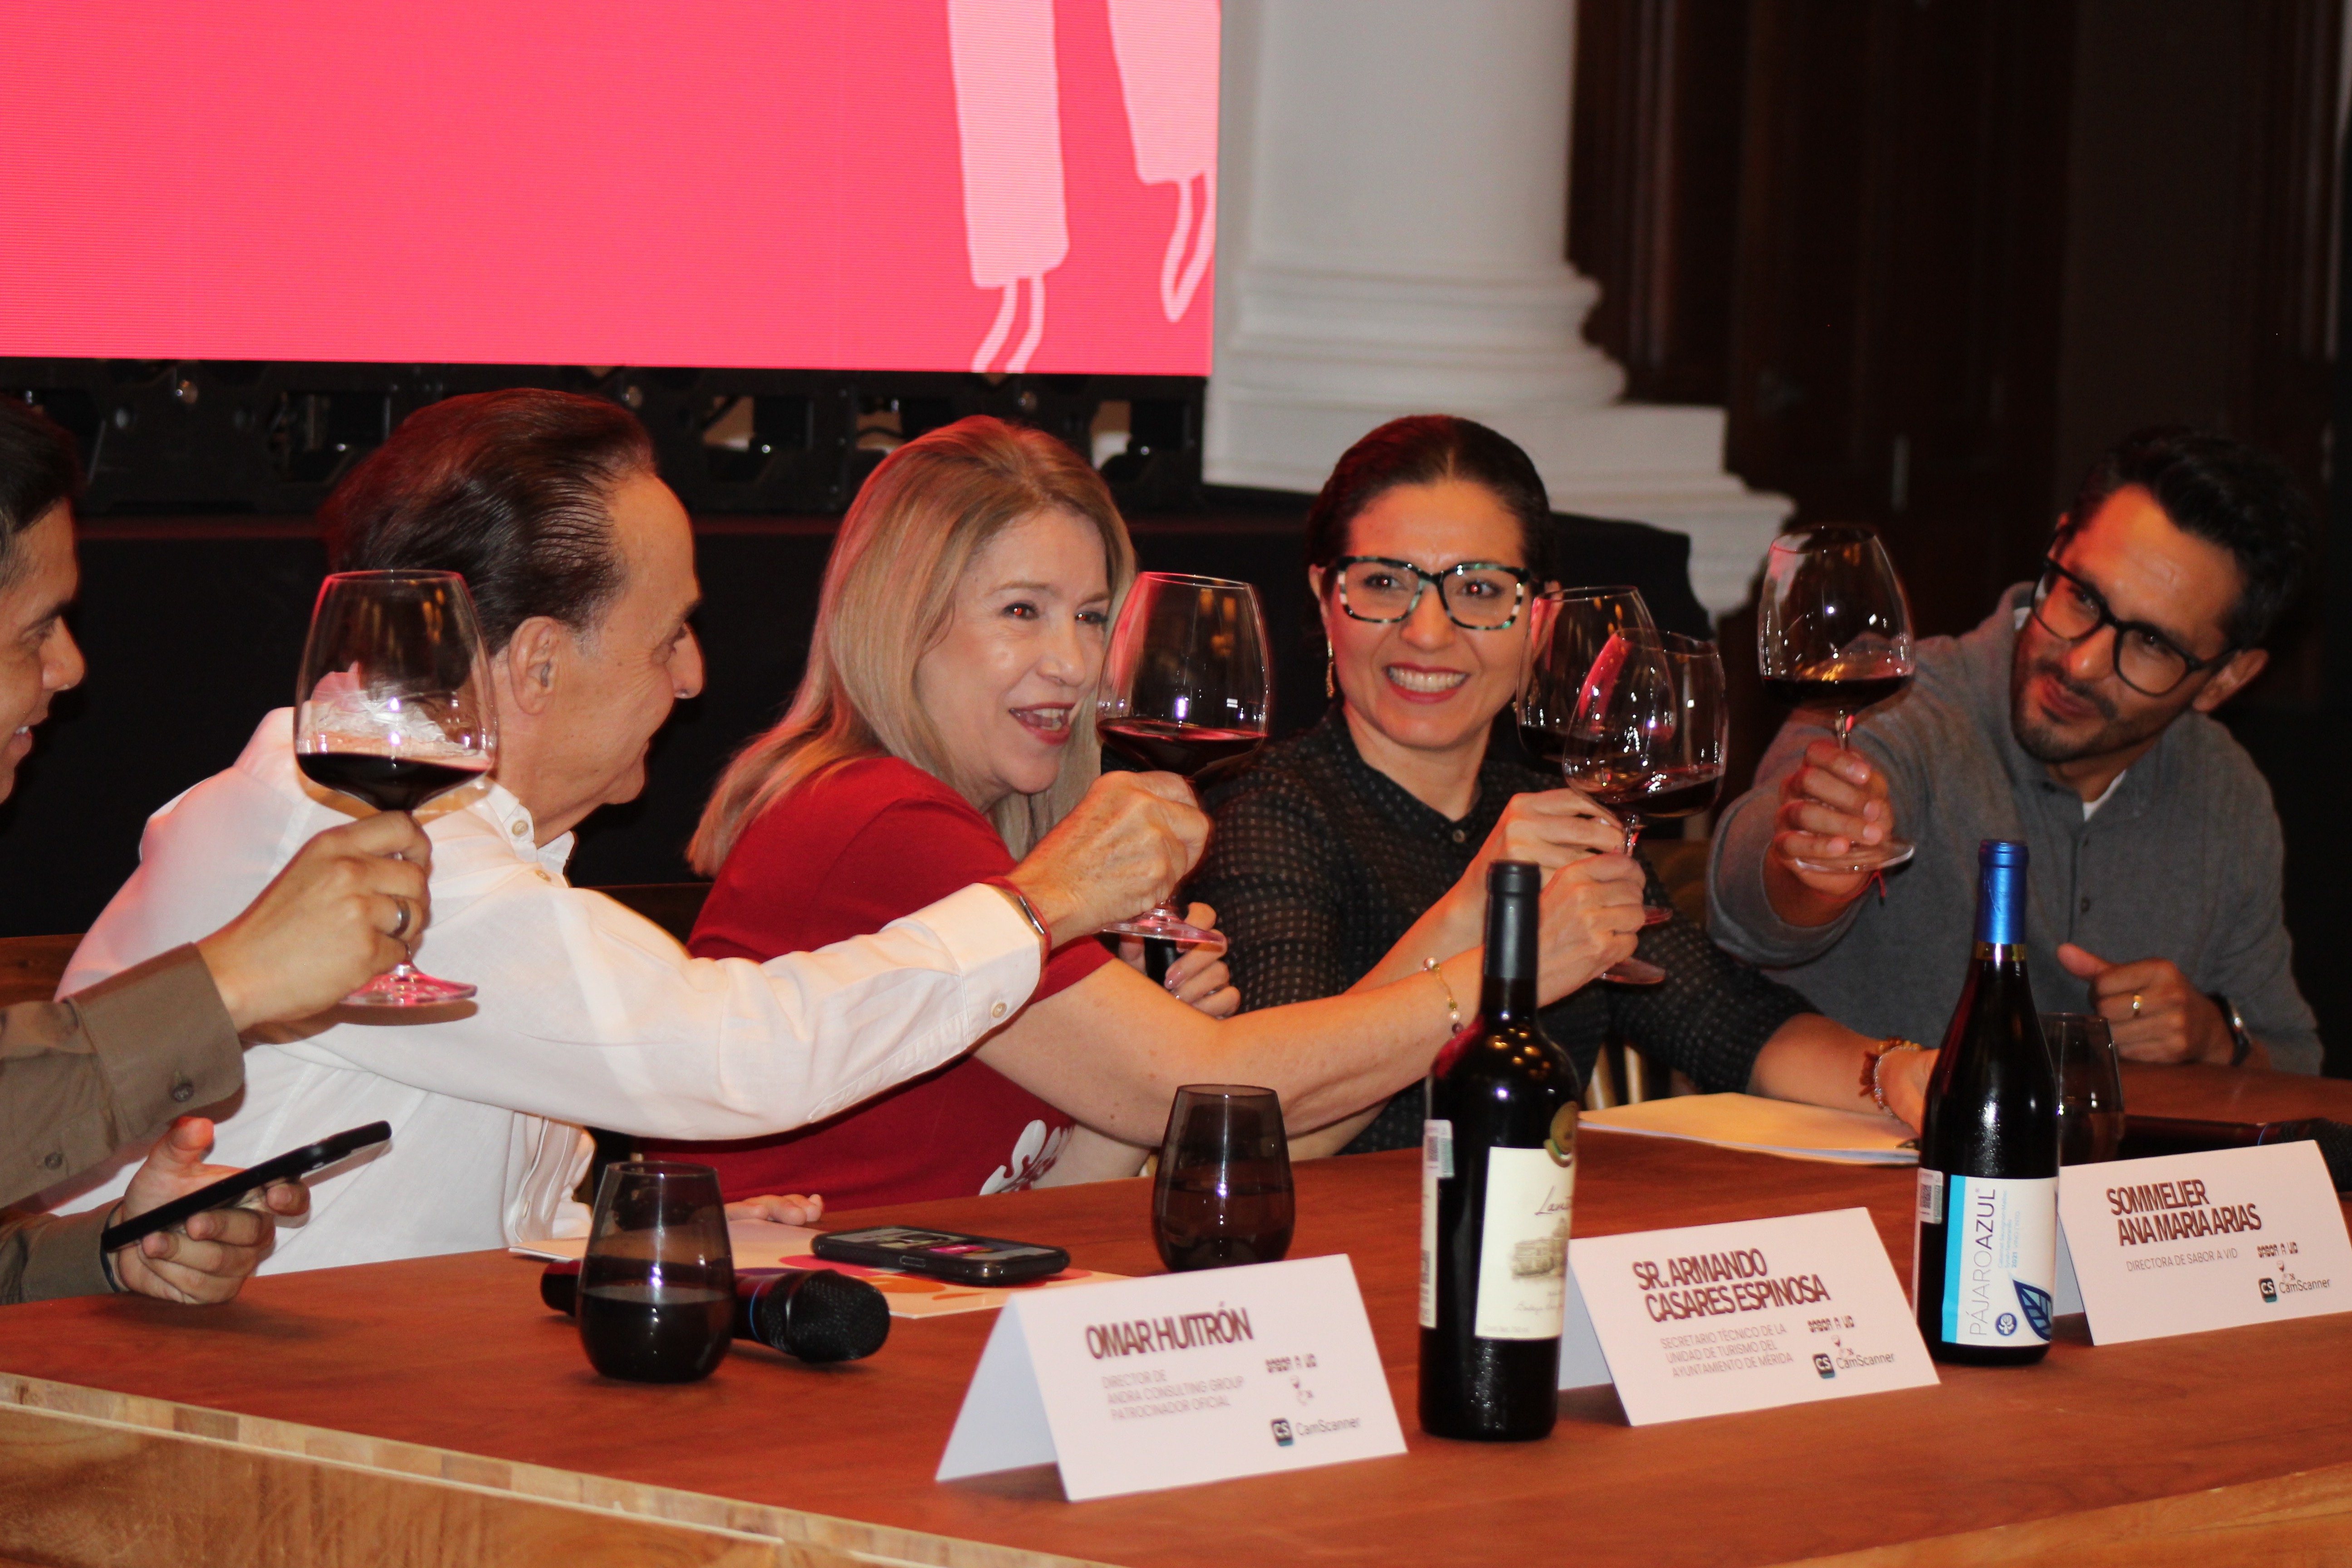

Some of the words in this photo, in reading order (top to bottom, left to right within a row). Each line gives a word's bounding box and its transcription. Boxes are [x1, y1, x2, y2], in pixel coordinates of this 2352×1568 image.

[2106, 1179, 2210, 1215] SOMMELIER
[2117, 1215, 2157, 1246] ANA
[2211, 1202, 2262, 1235] ARIAS
[1632, 1260, 1670, 1290] SR.
[1666, 1247, 1768, 1287] ARMANDO
[2126, 1256, 2173, 1271] DIRECTORA
[2174, 1254, 2185, 1265] DE
[2187, 1250, 2215, 1264] SABOR
[2216, 1250, 2223, 1260] A
[2223, 1248, 2238, 1259] VID
[1644, 1285, 1736, 1323] CASARES
[1731, 1274, 1831, 1311] ESPINOSA
[2261, 1282, 2274, 1294] CS
[2279, 1279, 2330, 1293] CamScanner
[1086, 1319, 1156, 1359] OMAR
[1152, 1301, 1253, 1349] HUITRÓN
[1660, 1332, 1716, 1349] SECRETARIO
[1760, 1324, 1773, 1336] DE
[1774, 1323, 1787, 1335] LA
[1665, 1349, 1702, 1363] UNIDAD
[1703, 1347, 1717, 1358] DE
[1717, 1342, 1759, 1356] TURISMO
[1759, 1339, 1778, 1351] DEL
[1815, 1357, 1832, 1371] CS
[1836, 1353, 1895, 1369] CamScanner
[1102, 1372, 1151, 1388] DIRECTOR
[1153, 1369, 1167, 1382] DE
[1672, 1359, 1743, 1377] AYUNTAMIENTO
[1744, 1356, 1758, 1368] DE
[1143, 1381, 1206, 1399] CONSULTING
[1209, 1376, 1244, 1391] GROUP
[1110, 1400, 1190, 1420] PATROCINADOR
[1191, 1395, 1230, 1410] OFICIAL
[1296, 1418, 1360, 1436] CamScanner
